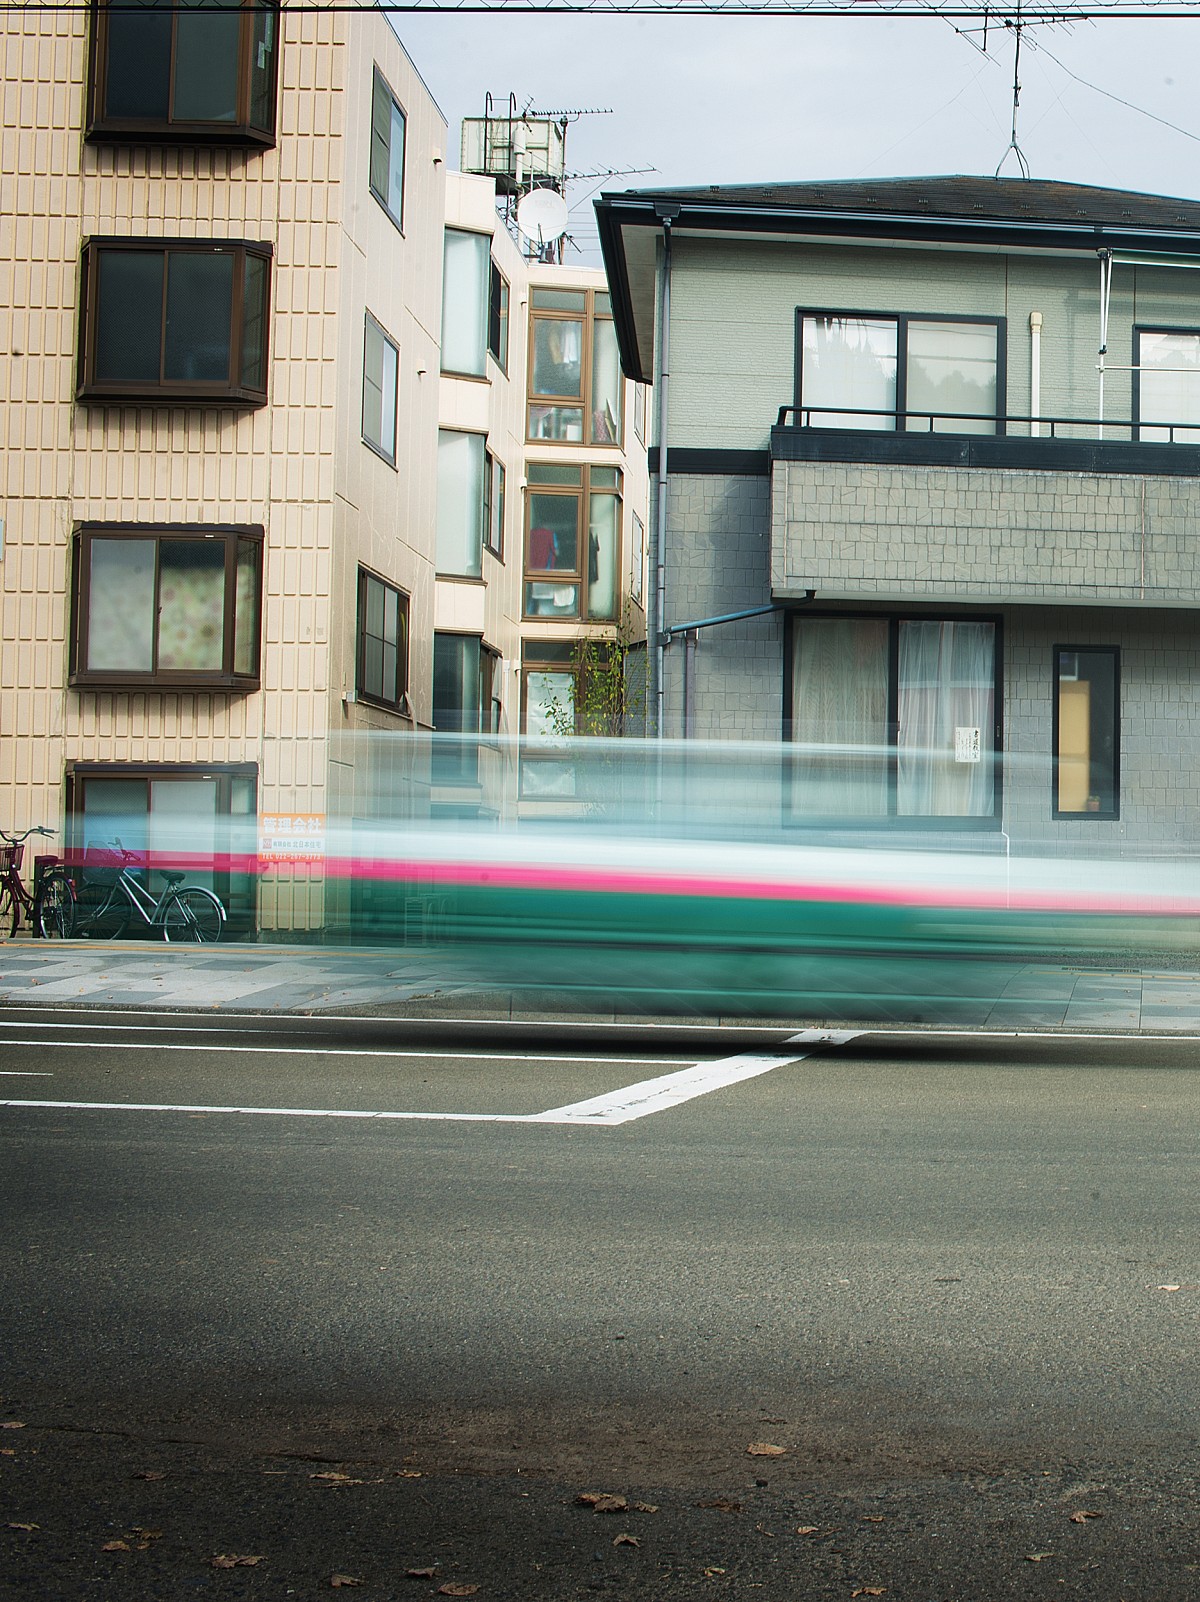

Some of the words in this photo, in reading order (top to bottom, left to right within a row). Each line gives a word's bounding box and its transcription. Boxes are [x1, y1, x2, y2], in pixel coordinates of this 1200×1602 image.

[263, 816, 322, 833] 管理会社
[262, 852, 274, 860] TEL
